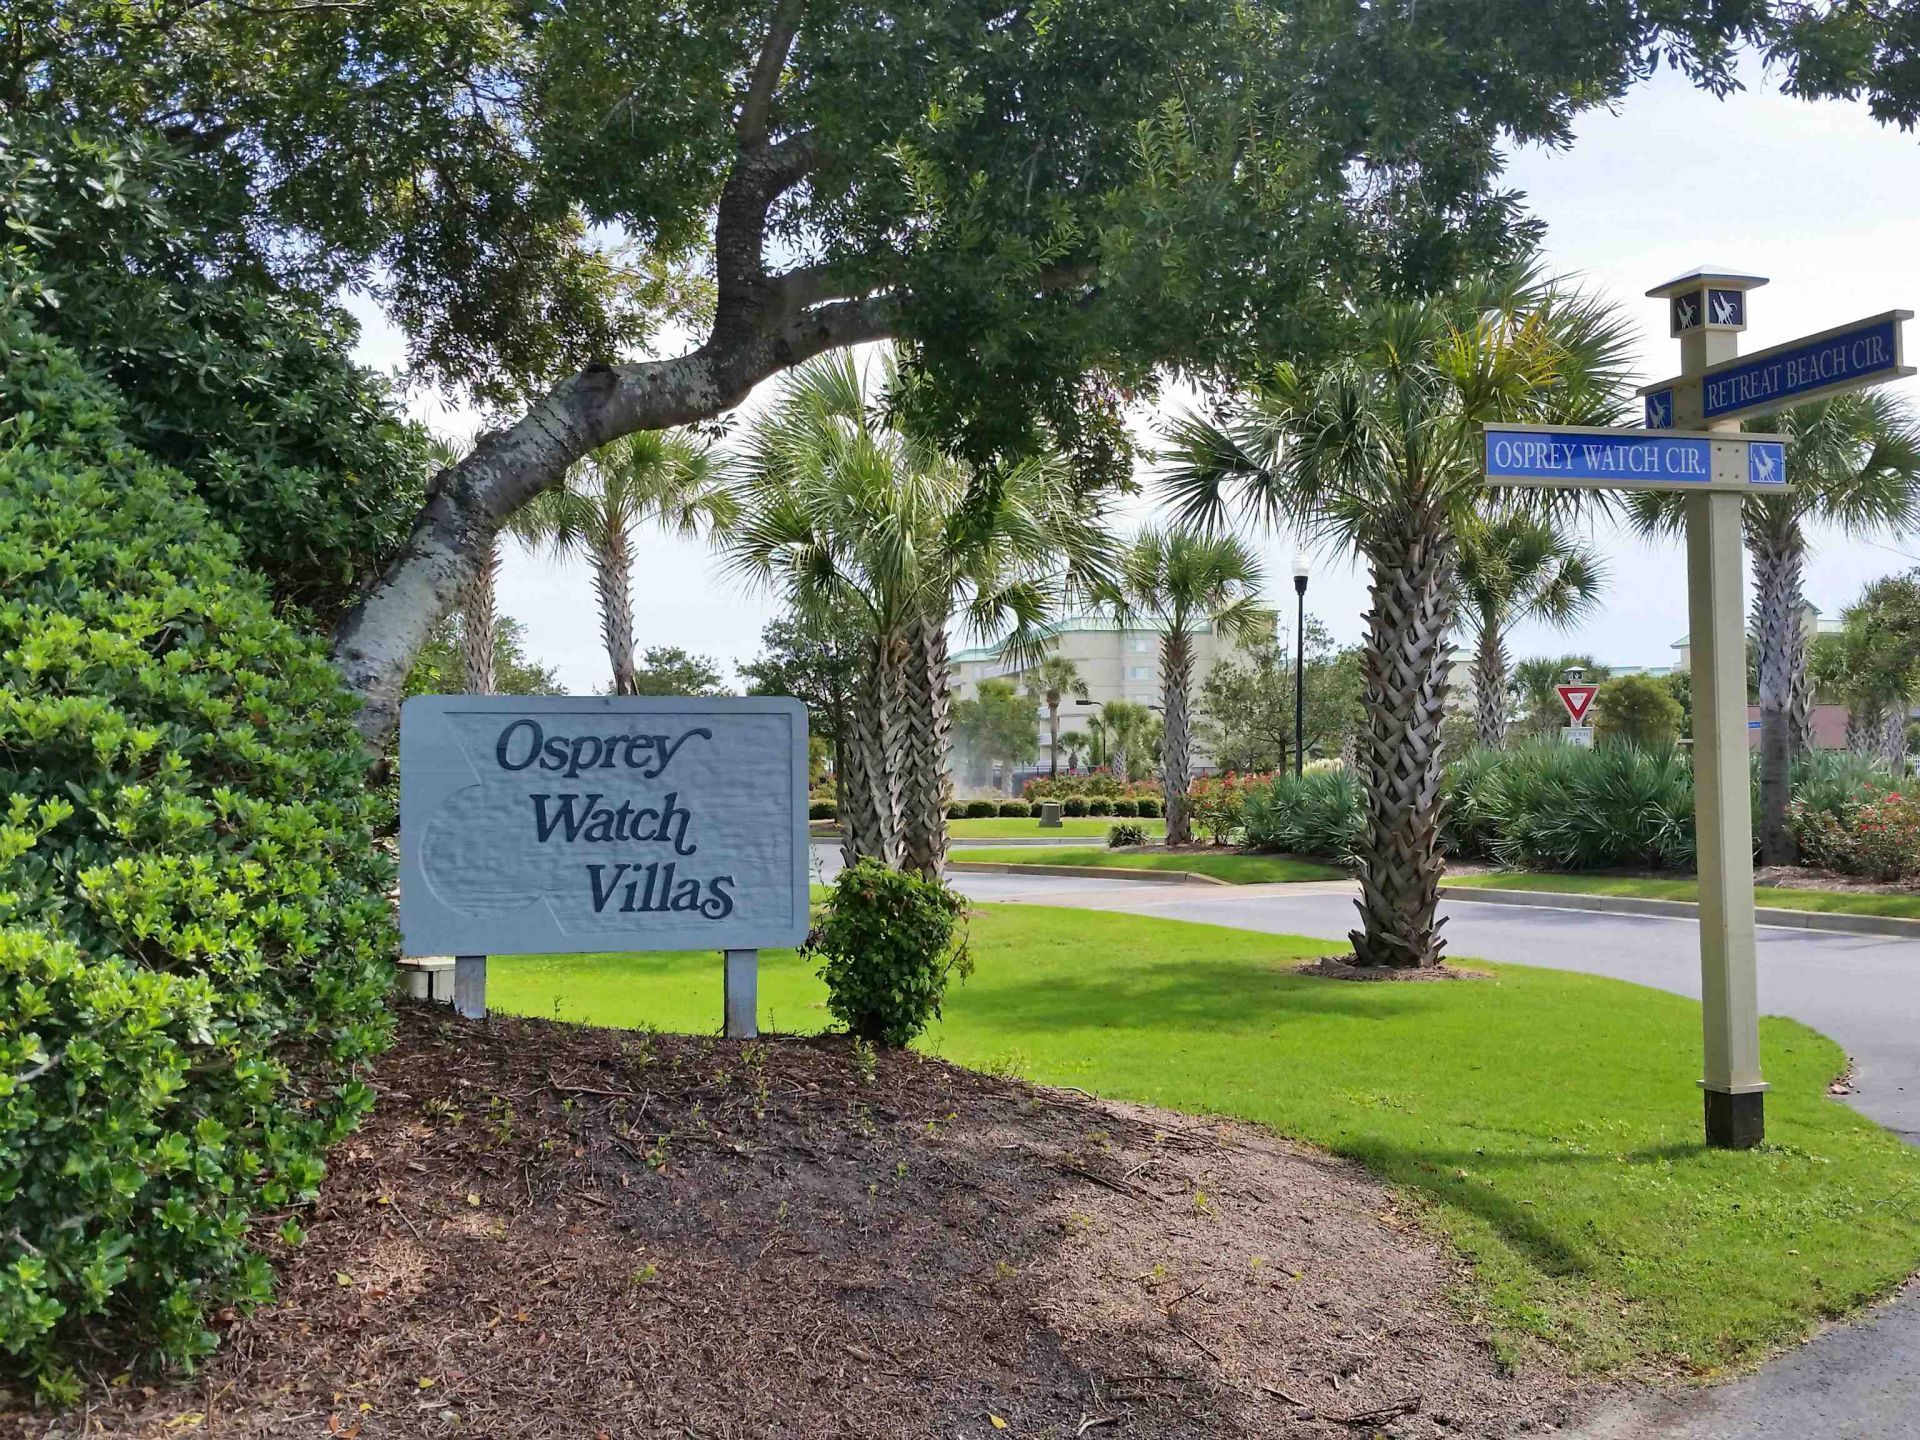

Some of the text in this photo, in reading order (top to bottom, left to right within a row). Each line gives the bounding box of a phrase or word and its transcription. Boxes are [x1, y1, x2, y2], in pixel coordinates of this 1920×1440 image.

[1708, 335, 1889, 410] RETREAT BEACH CIR.
[1495, 441, 1706, 474] OSPREY WATCH CIR.
[496, 719, 712, 779] Osprey
[529, 792, 697, 856] Watch
[586, 862, 736, 920] Villas
